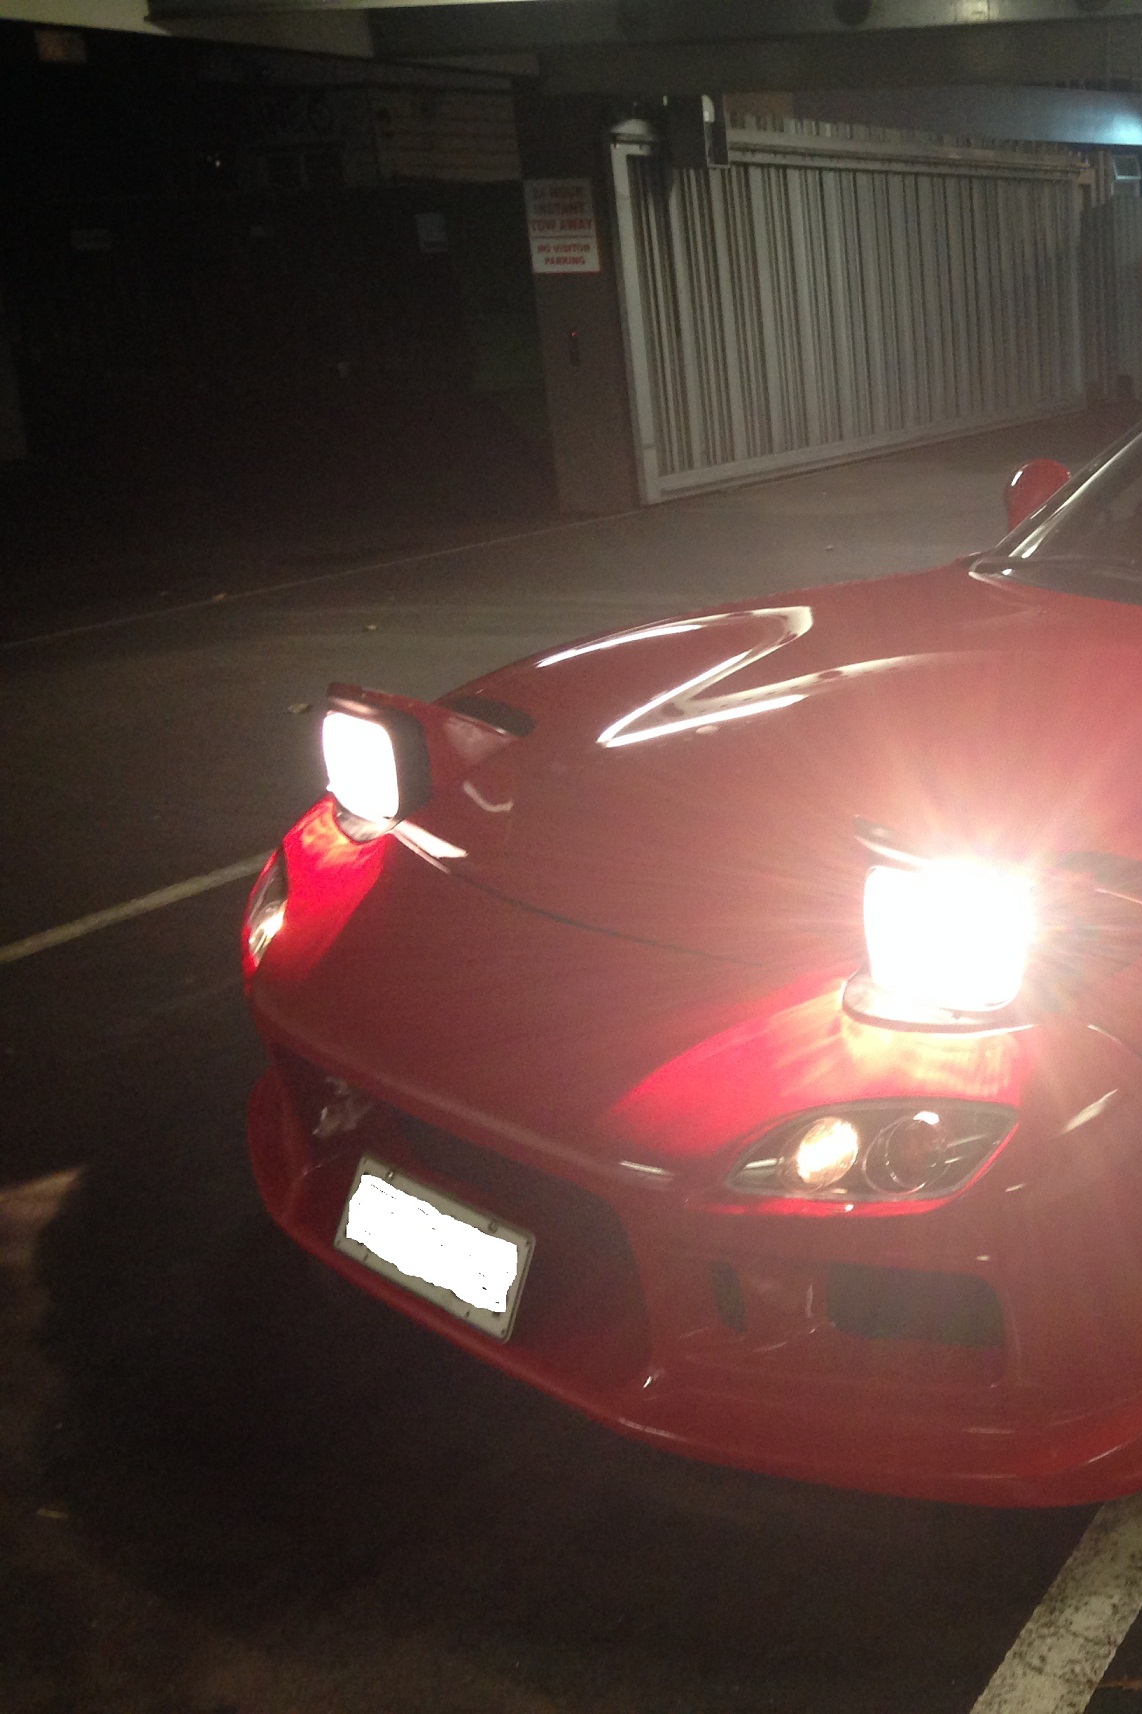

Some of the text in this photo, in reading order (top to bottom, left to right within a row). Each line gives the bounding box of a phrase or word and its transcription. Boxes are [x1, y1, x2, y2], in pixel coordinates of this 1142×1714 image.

[531, 217, 592, 231] TOW AWAY
[537, 243, 590, 253] NO VISITOR
[544, 256, 586, 265] PARKING
